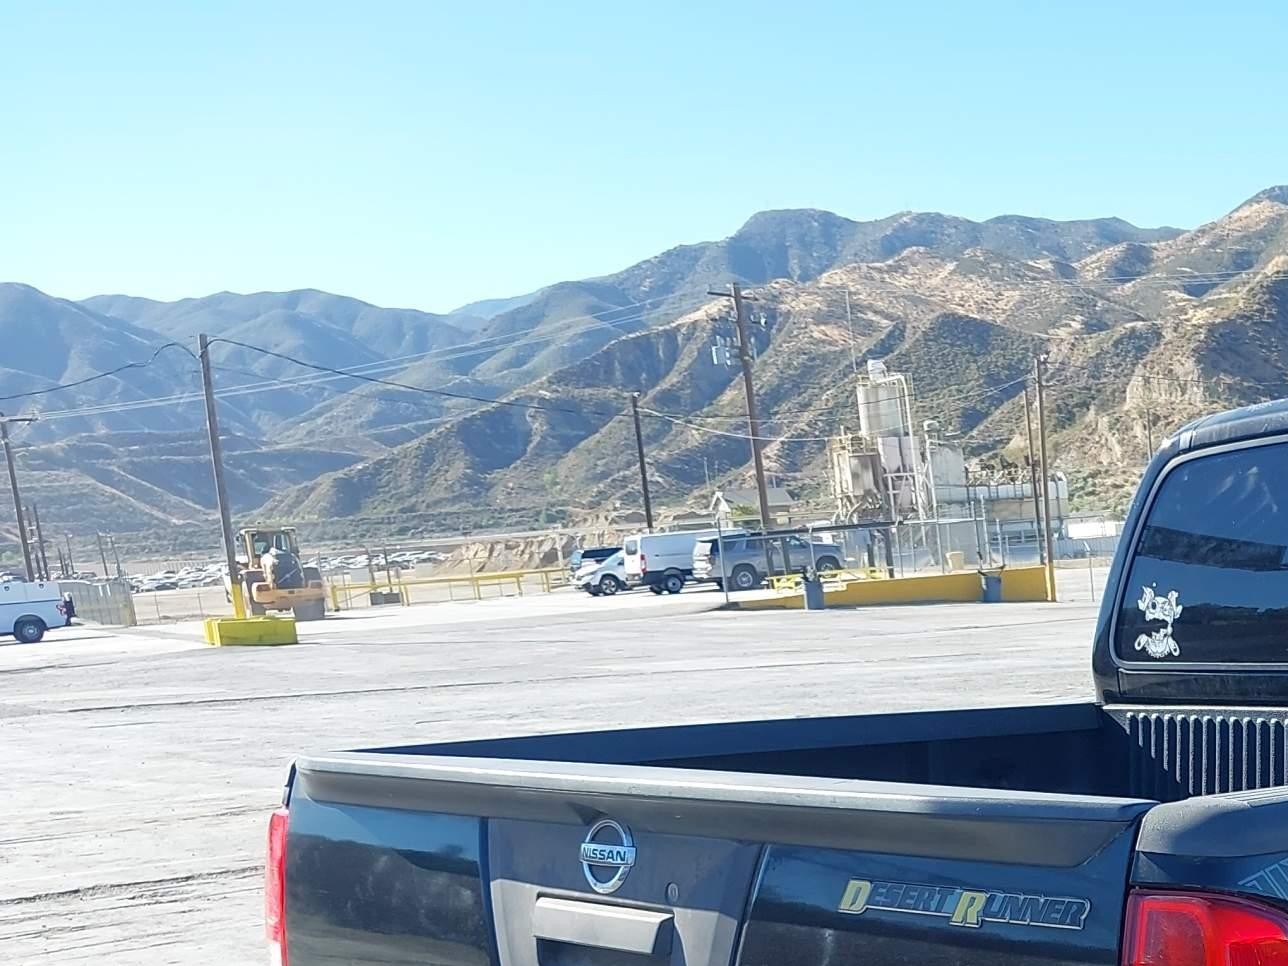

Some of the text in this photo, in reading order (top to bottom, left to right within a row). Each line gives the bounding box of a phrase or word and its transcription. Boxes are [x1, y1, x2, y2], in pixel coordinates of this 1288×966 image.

[582, 846, 627, 862] NISSAN
[838, 879, 1089, 928] DESERT RUNNER
